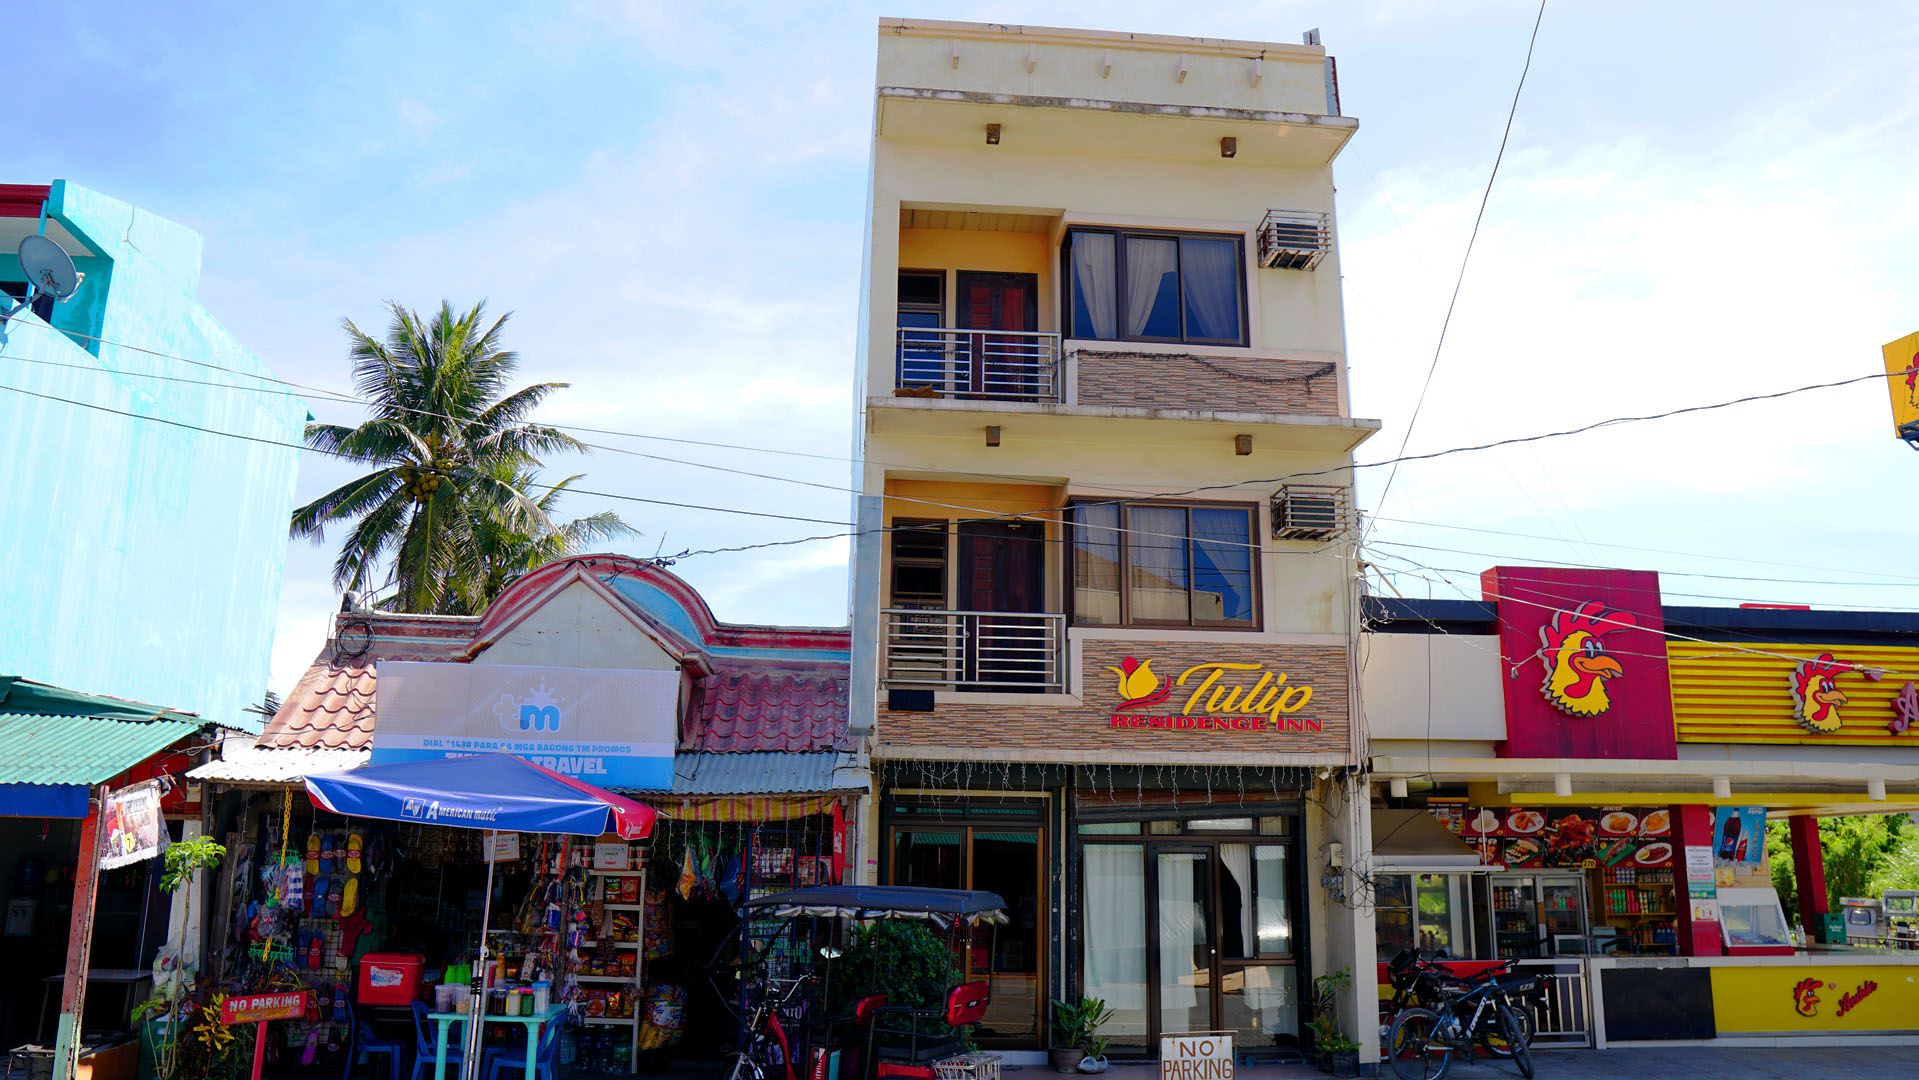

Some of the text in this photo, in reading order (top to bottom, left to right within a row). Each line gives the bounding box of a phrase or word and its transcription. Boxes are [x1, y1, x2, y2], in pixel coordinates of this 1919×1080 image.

[1175, 662, 1313, 723] Tulip
[1110, 715, 1324, 733] RESIDENCE INN
[423, 739, 443, 748] DIAL
[474, 741, 498, 750] PARA
[514, 743, 535, 751] MGA
[537, 744, 574, 752] BAGONG
[576, 744, 590, 753] TM
[592, 745, 632, 754] PROMOS
[531, 757, 607, 775] TRAVEL
[229, 995, 300, 1012] NO PARKING
[1179, 1040, 1215, 1058] NO
[1163, 1058, 1233, 1080] PARKING
